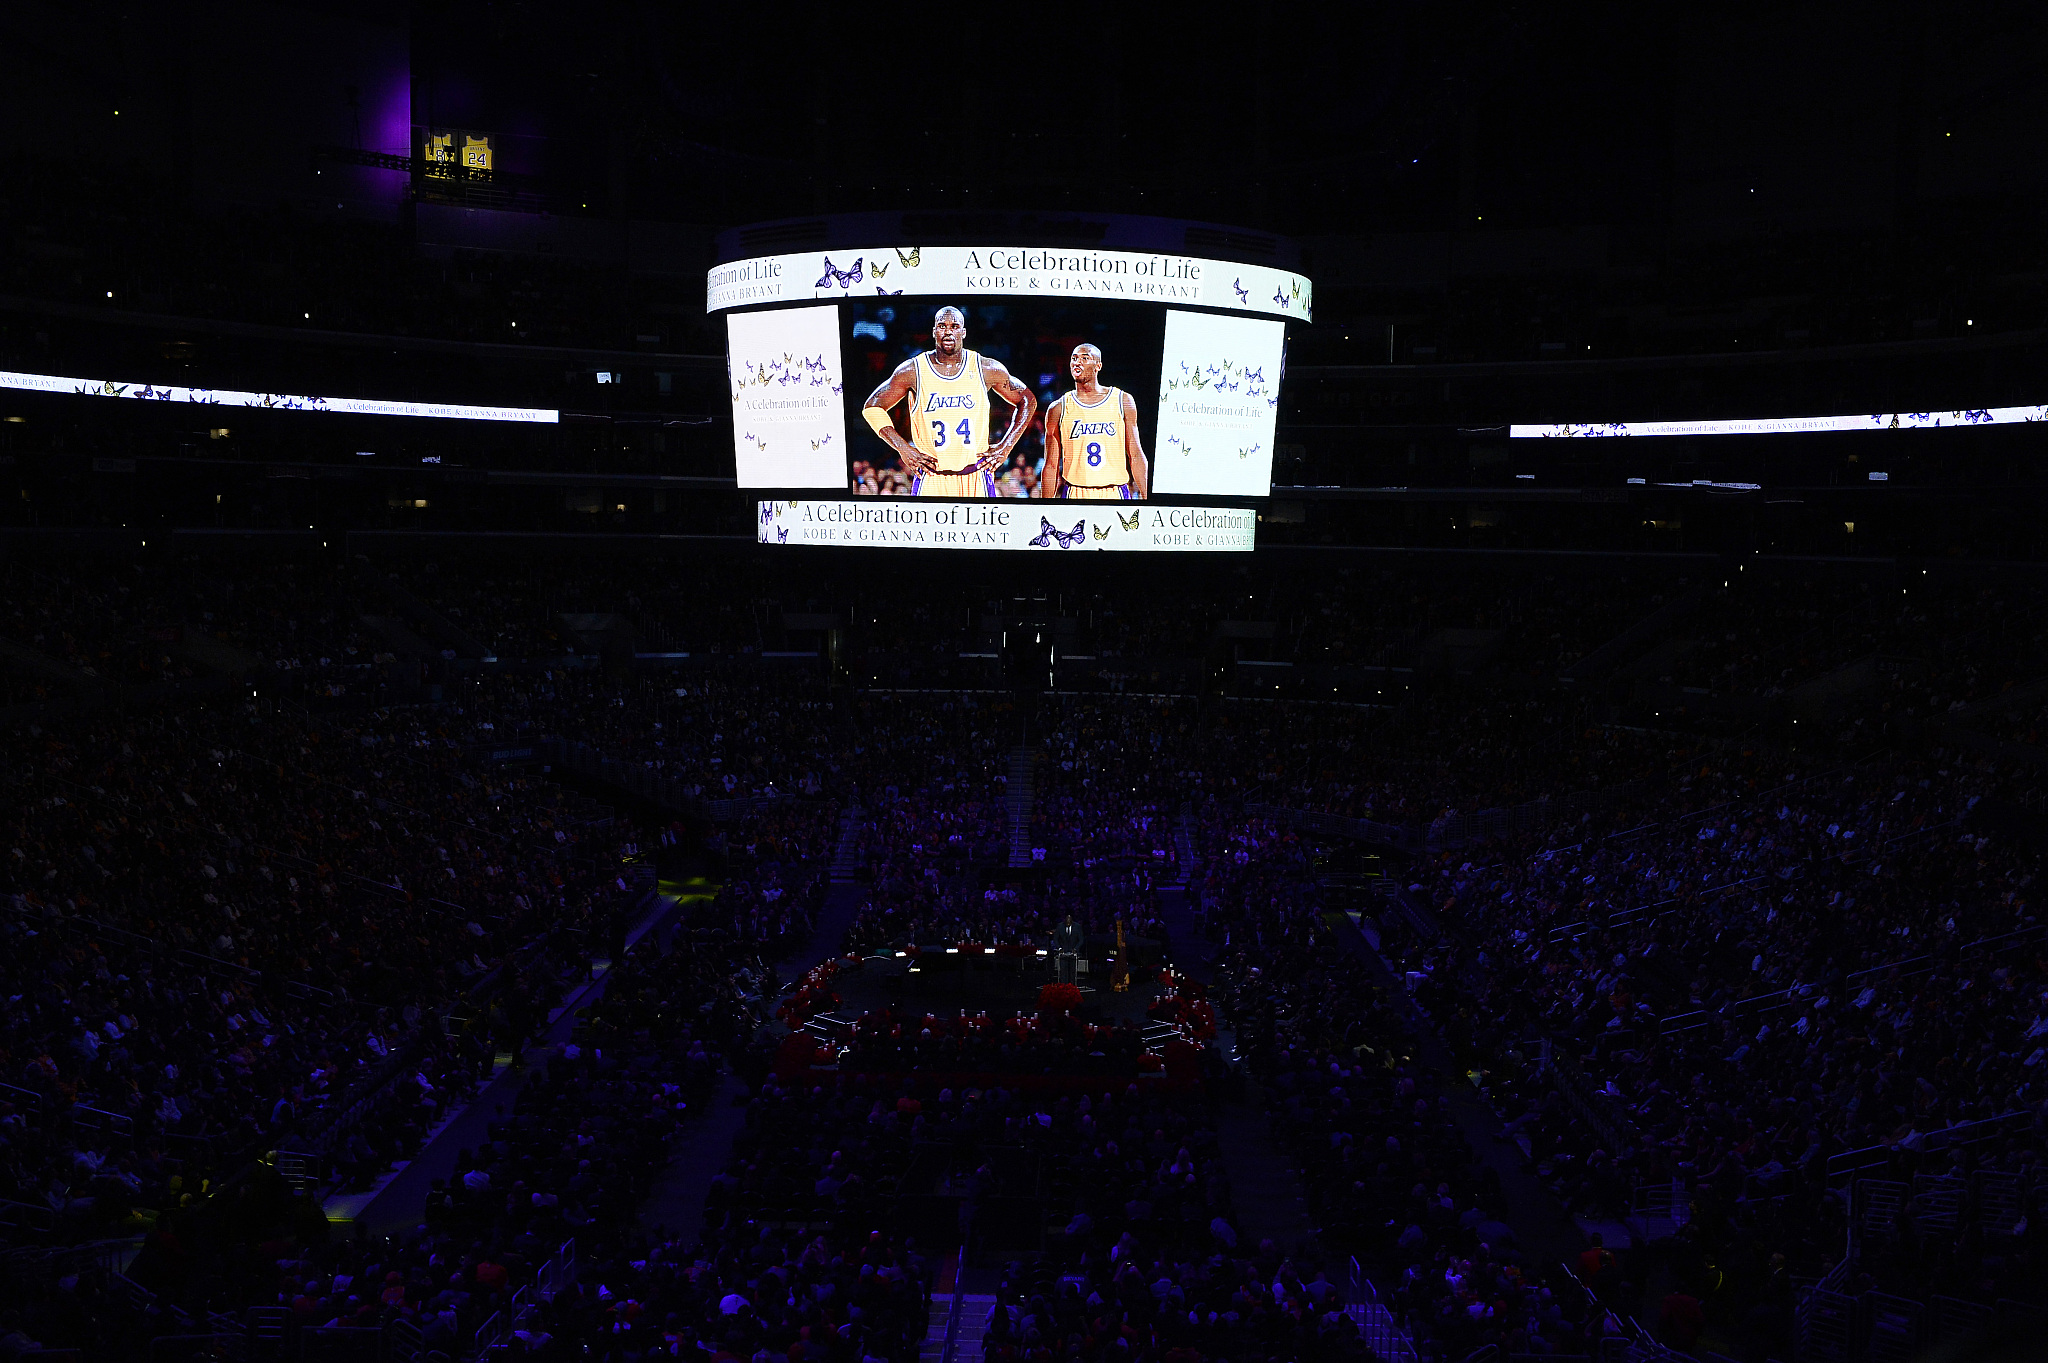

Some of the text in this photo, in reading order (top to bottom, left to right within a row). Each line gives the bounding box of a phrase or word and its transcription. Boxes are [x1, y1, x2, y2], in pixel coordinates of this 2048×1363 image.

[468, 152, 486, 166] 24
[740, 262, 751, 281] of
[755, 258, 782, 279] Life
[965, 250, 1200, 280] A Celebration of Life
[740, 284, 782, 300] BRYANT
[966, 276, 1200, 298] KOBE & GIANNA BRYANT
[752, 398, 800, 409] Celebration
[924, 393, 976, 413] LAKERS
[1069, 420, 1116, 439] LAKERS
[1087, 442, 1101, 467] 8
[802, 504, 1010, 525] A Celebration of Life
[1151, 510, 1164, 527] A
[1170, 510, 1242, 529] Celebration
[803, 528, 1010, 543] KOBE & GIANNA BRYANT
[1153, 534, 1190, 545] KOBE
[1195, 535, 1203, 545] &
[1207, 535, 1240, 546] GIANNA
